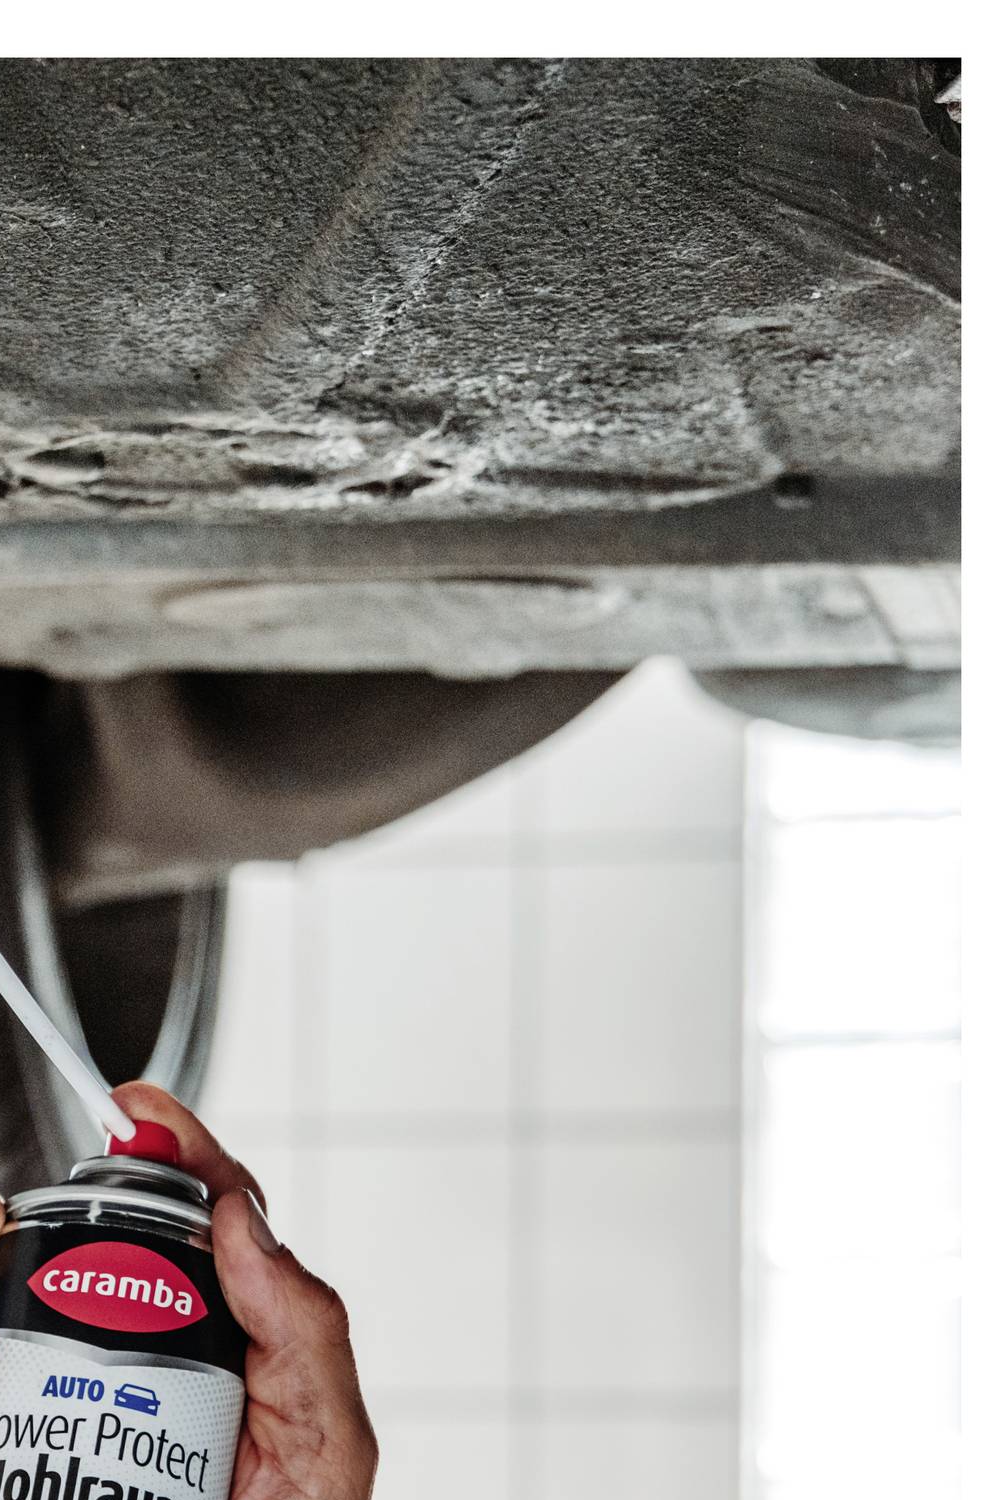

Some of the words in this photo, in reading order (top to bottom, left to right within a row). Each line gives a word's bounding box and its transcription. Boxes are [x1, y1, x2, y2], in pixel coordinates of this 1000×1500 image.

[42, 1269, 193, 1316] caramba
[41, 1375, 105, 1402] AUTO
[94, 1412, 210, 1493] Protect
